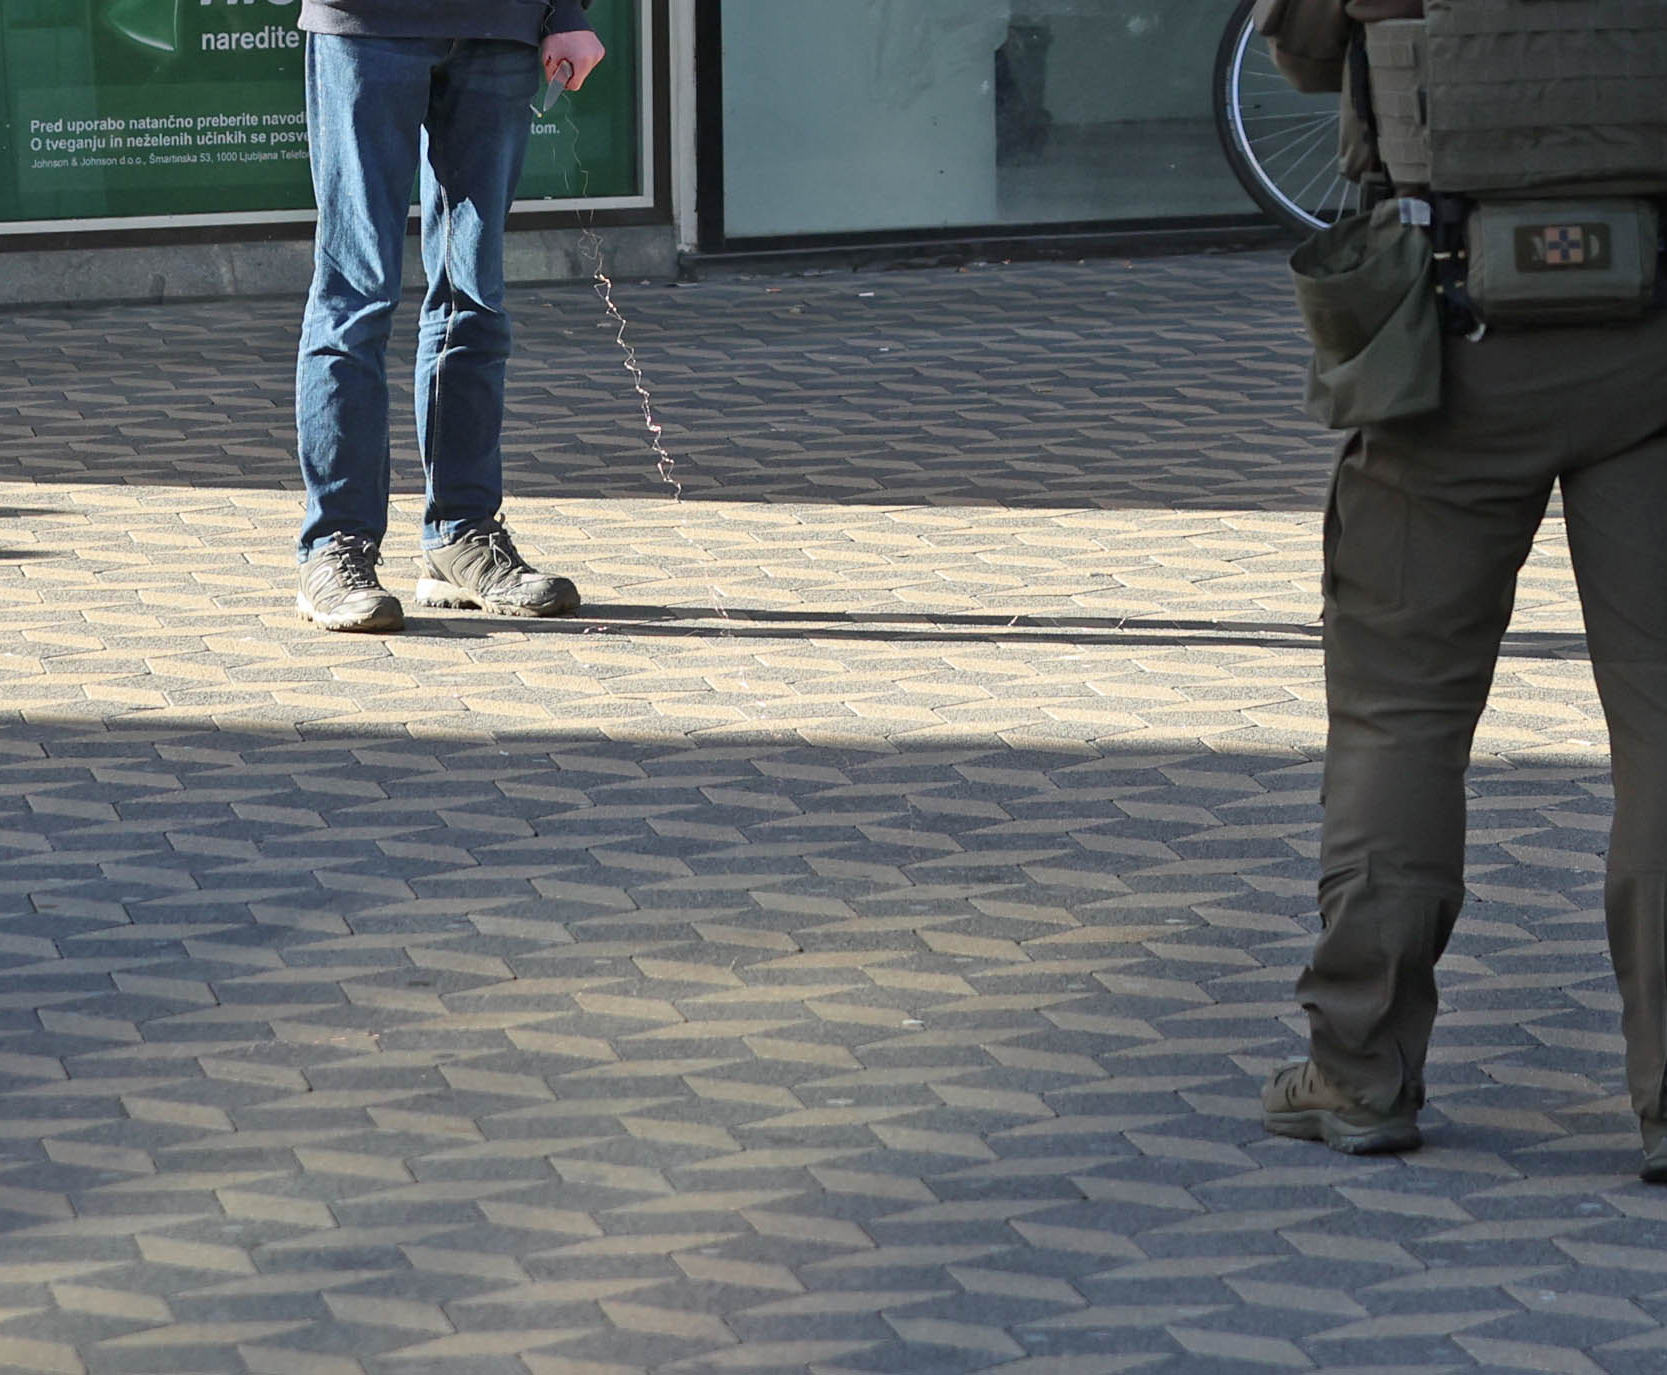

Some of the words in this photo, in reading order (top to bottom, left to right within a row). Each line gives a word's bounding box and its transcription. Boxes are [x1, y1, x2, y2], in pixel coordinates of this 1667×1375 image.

[201, 25, 300, 51] naredite
[30, 118, 63, 133] Pred
[67, 116, 125, 134] uporabo
[129, 114, 193, 130] natančno
[197, 112, 258, 130] preberite
[531, 122, 560, 134] tom.
[30, 137, 42, 151] O
[45, 135, 106, 153] tveganju
[110, 134, 123, 148] in
[127, 132, 192, 147] neželenih
[196, 130, 246, 145] učinkih
[250, 133, 266, 143] se
[32, 159, 69, 169] Johnson
[81, 155, 118, 166] Johnson
[199, 152, 214, 164] 53,
[217, 151, 237, 162] 1000
[239, 150, 278, 163] Ljubljana
